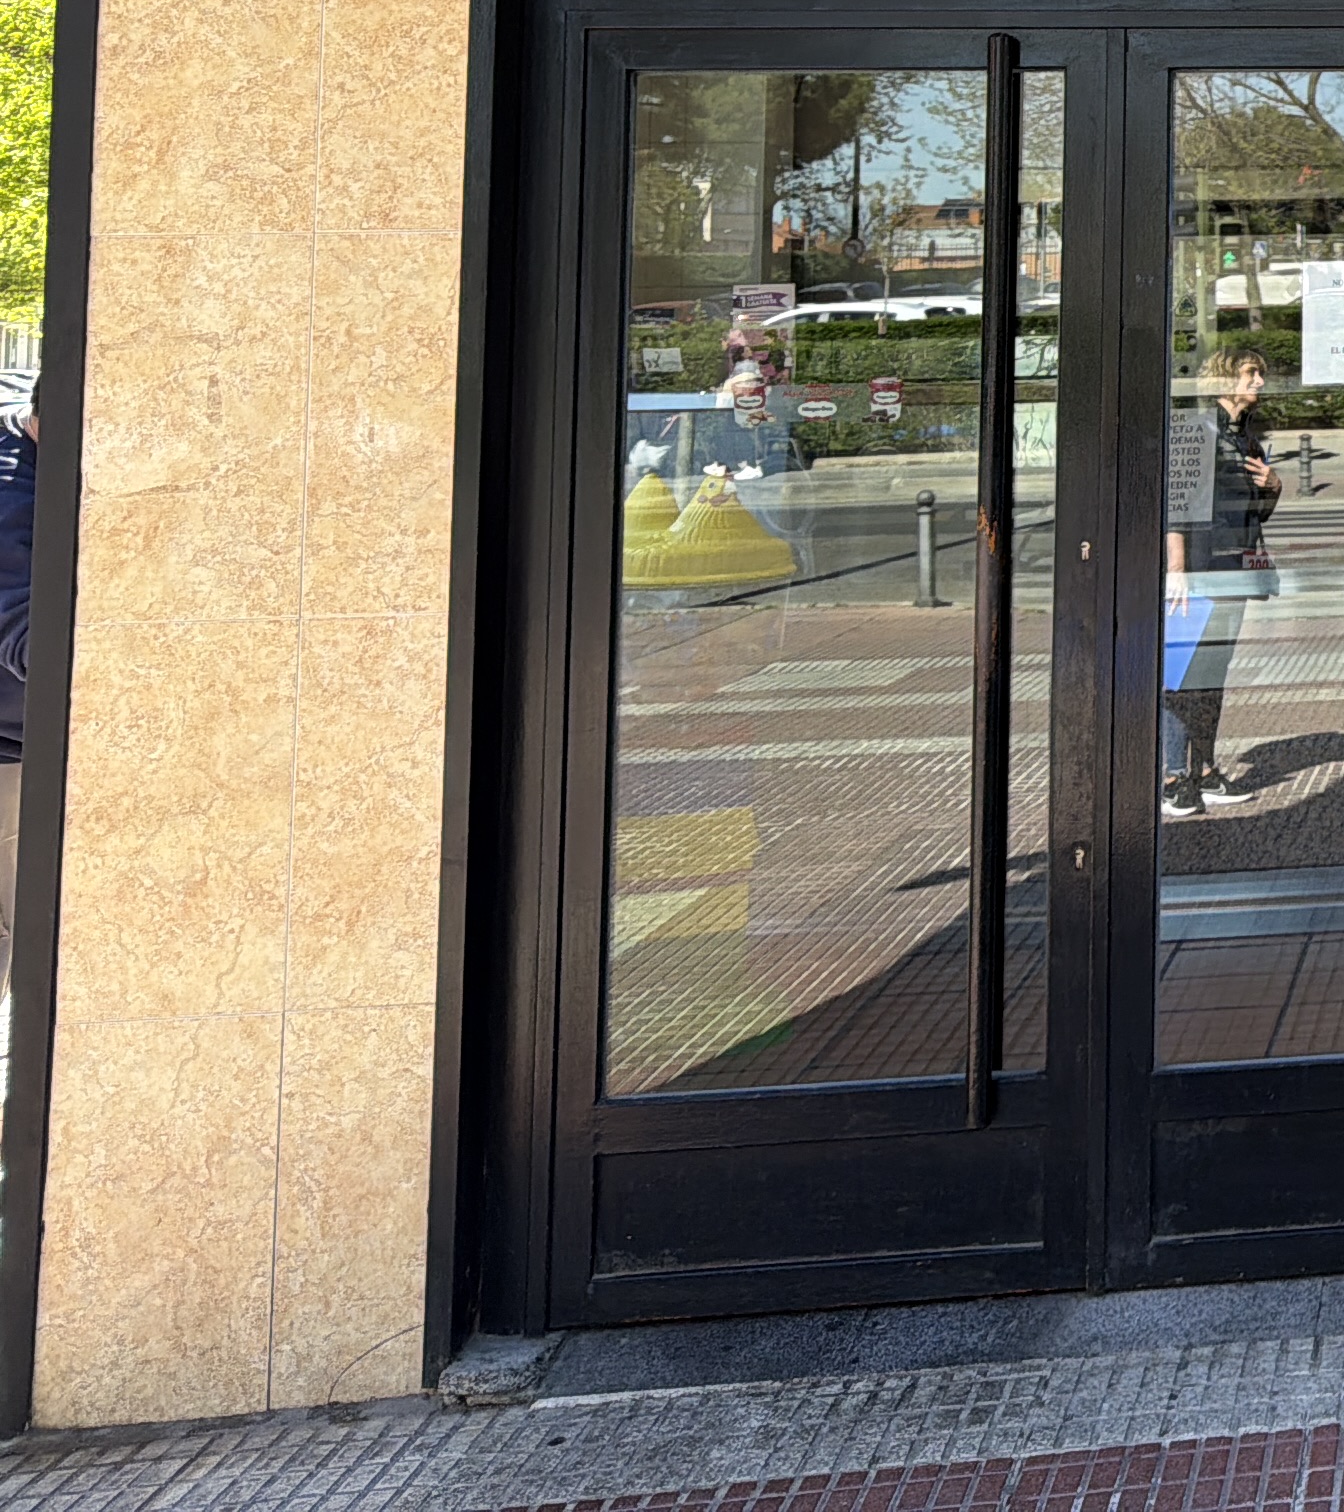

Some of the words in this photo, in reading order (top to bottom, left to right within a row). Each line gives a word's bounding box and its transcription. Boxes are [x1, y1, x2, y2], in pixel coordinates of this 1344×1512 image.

[746, 293, 773, 301] SEMANA
[1330, 346, 1340, 354] EL
[1170, 413, 1186, 423] OR
[1170, 424, 1194, 433] ETO
[1196, 424, 1204, 433] A
[1170, 435, 1206, 445] DEMAS
[1180, 457, 1201, 466] LOS
[1185, 469, 1201, 478] NO
